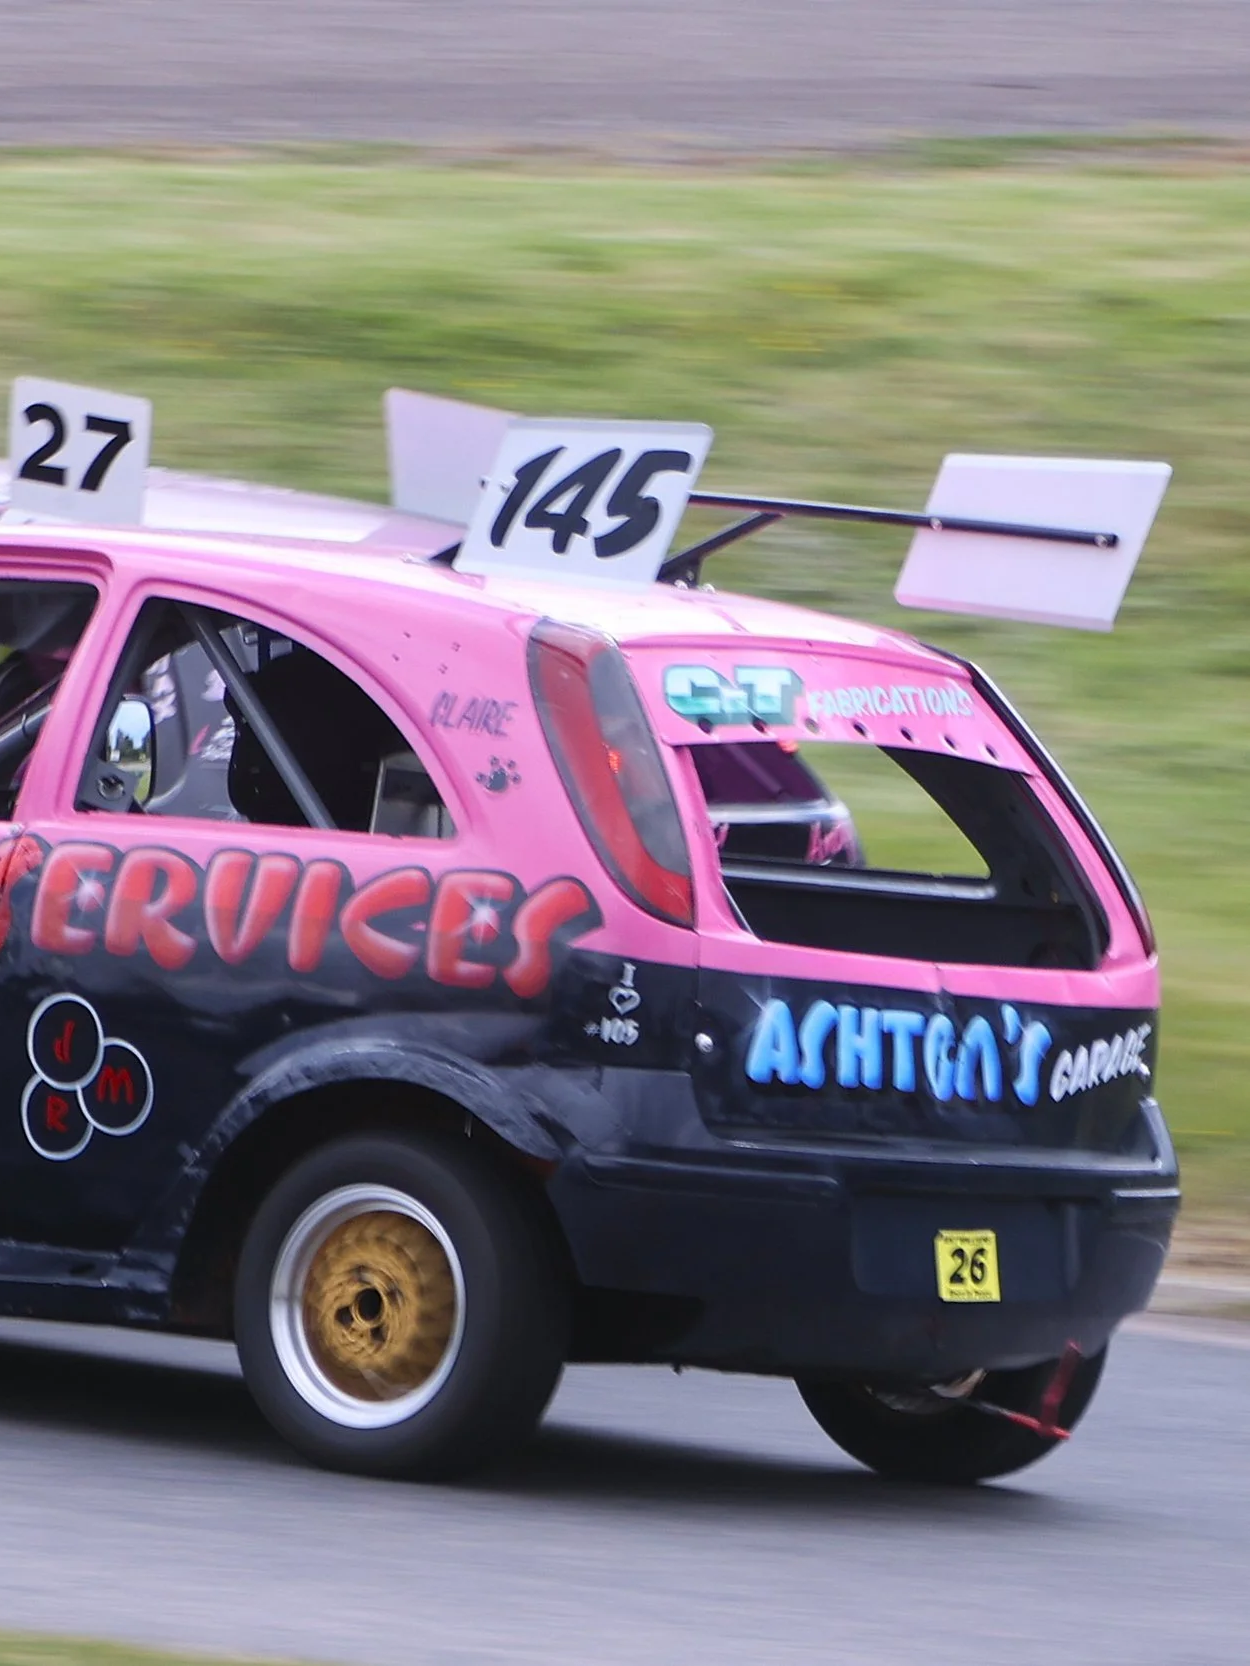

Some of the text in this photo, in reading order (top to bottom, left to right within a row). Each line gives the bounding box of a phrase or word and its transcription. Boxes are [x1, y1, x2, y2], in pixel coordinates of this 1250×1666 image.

[18, 401, 135, 492] 27
[489, 445, 693, 559] 145
[428, 689, 519, 737] CLAIRE
[807, 684, 975, 718] FABRICATIONS
[744, 997, 1152, 1108] ASHTON'S GARAGE
[45, 1095, 70, 1133] R
[948, 1247, 988, 1286] 26
